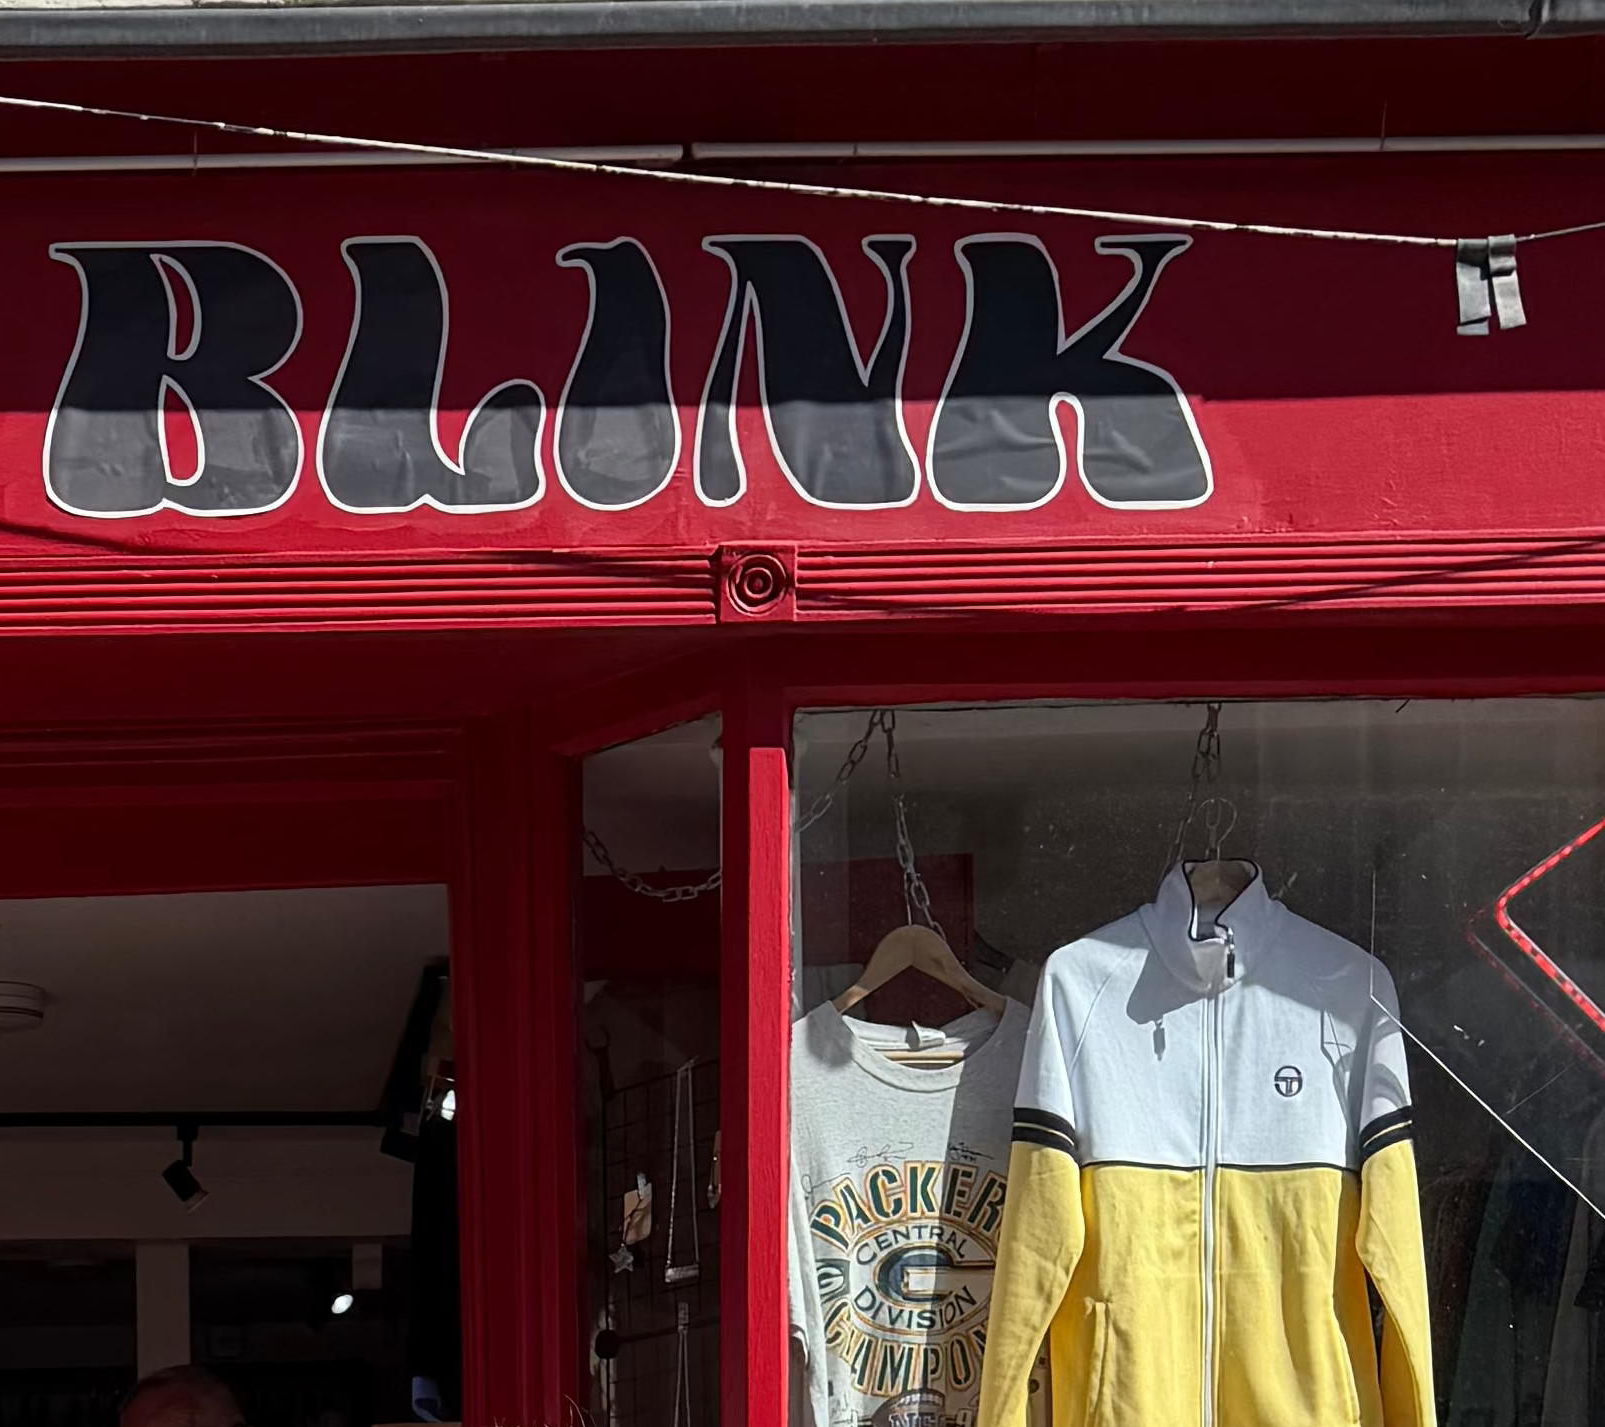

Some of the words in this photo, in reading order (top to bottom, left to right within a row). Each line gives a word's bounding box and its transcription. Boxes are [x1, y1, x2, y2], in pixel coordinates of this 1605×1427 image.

[41, 234, 1215, 518] BLINK
[856, 1225, 966, 1266] CENTRAL
[854, 1283, 978, 1330] DIVISION
